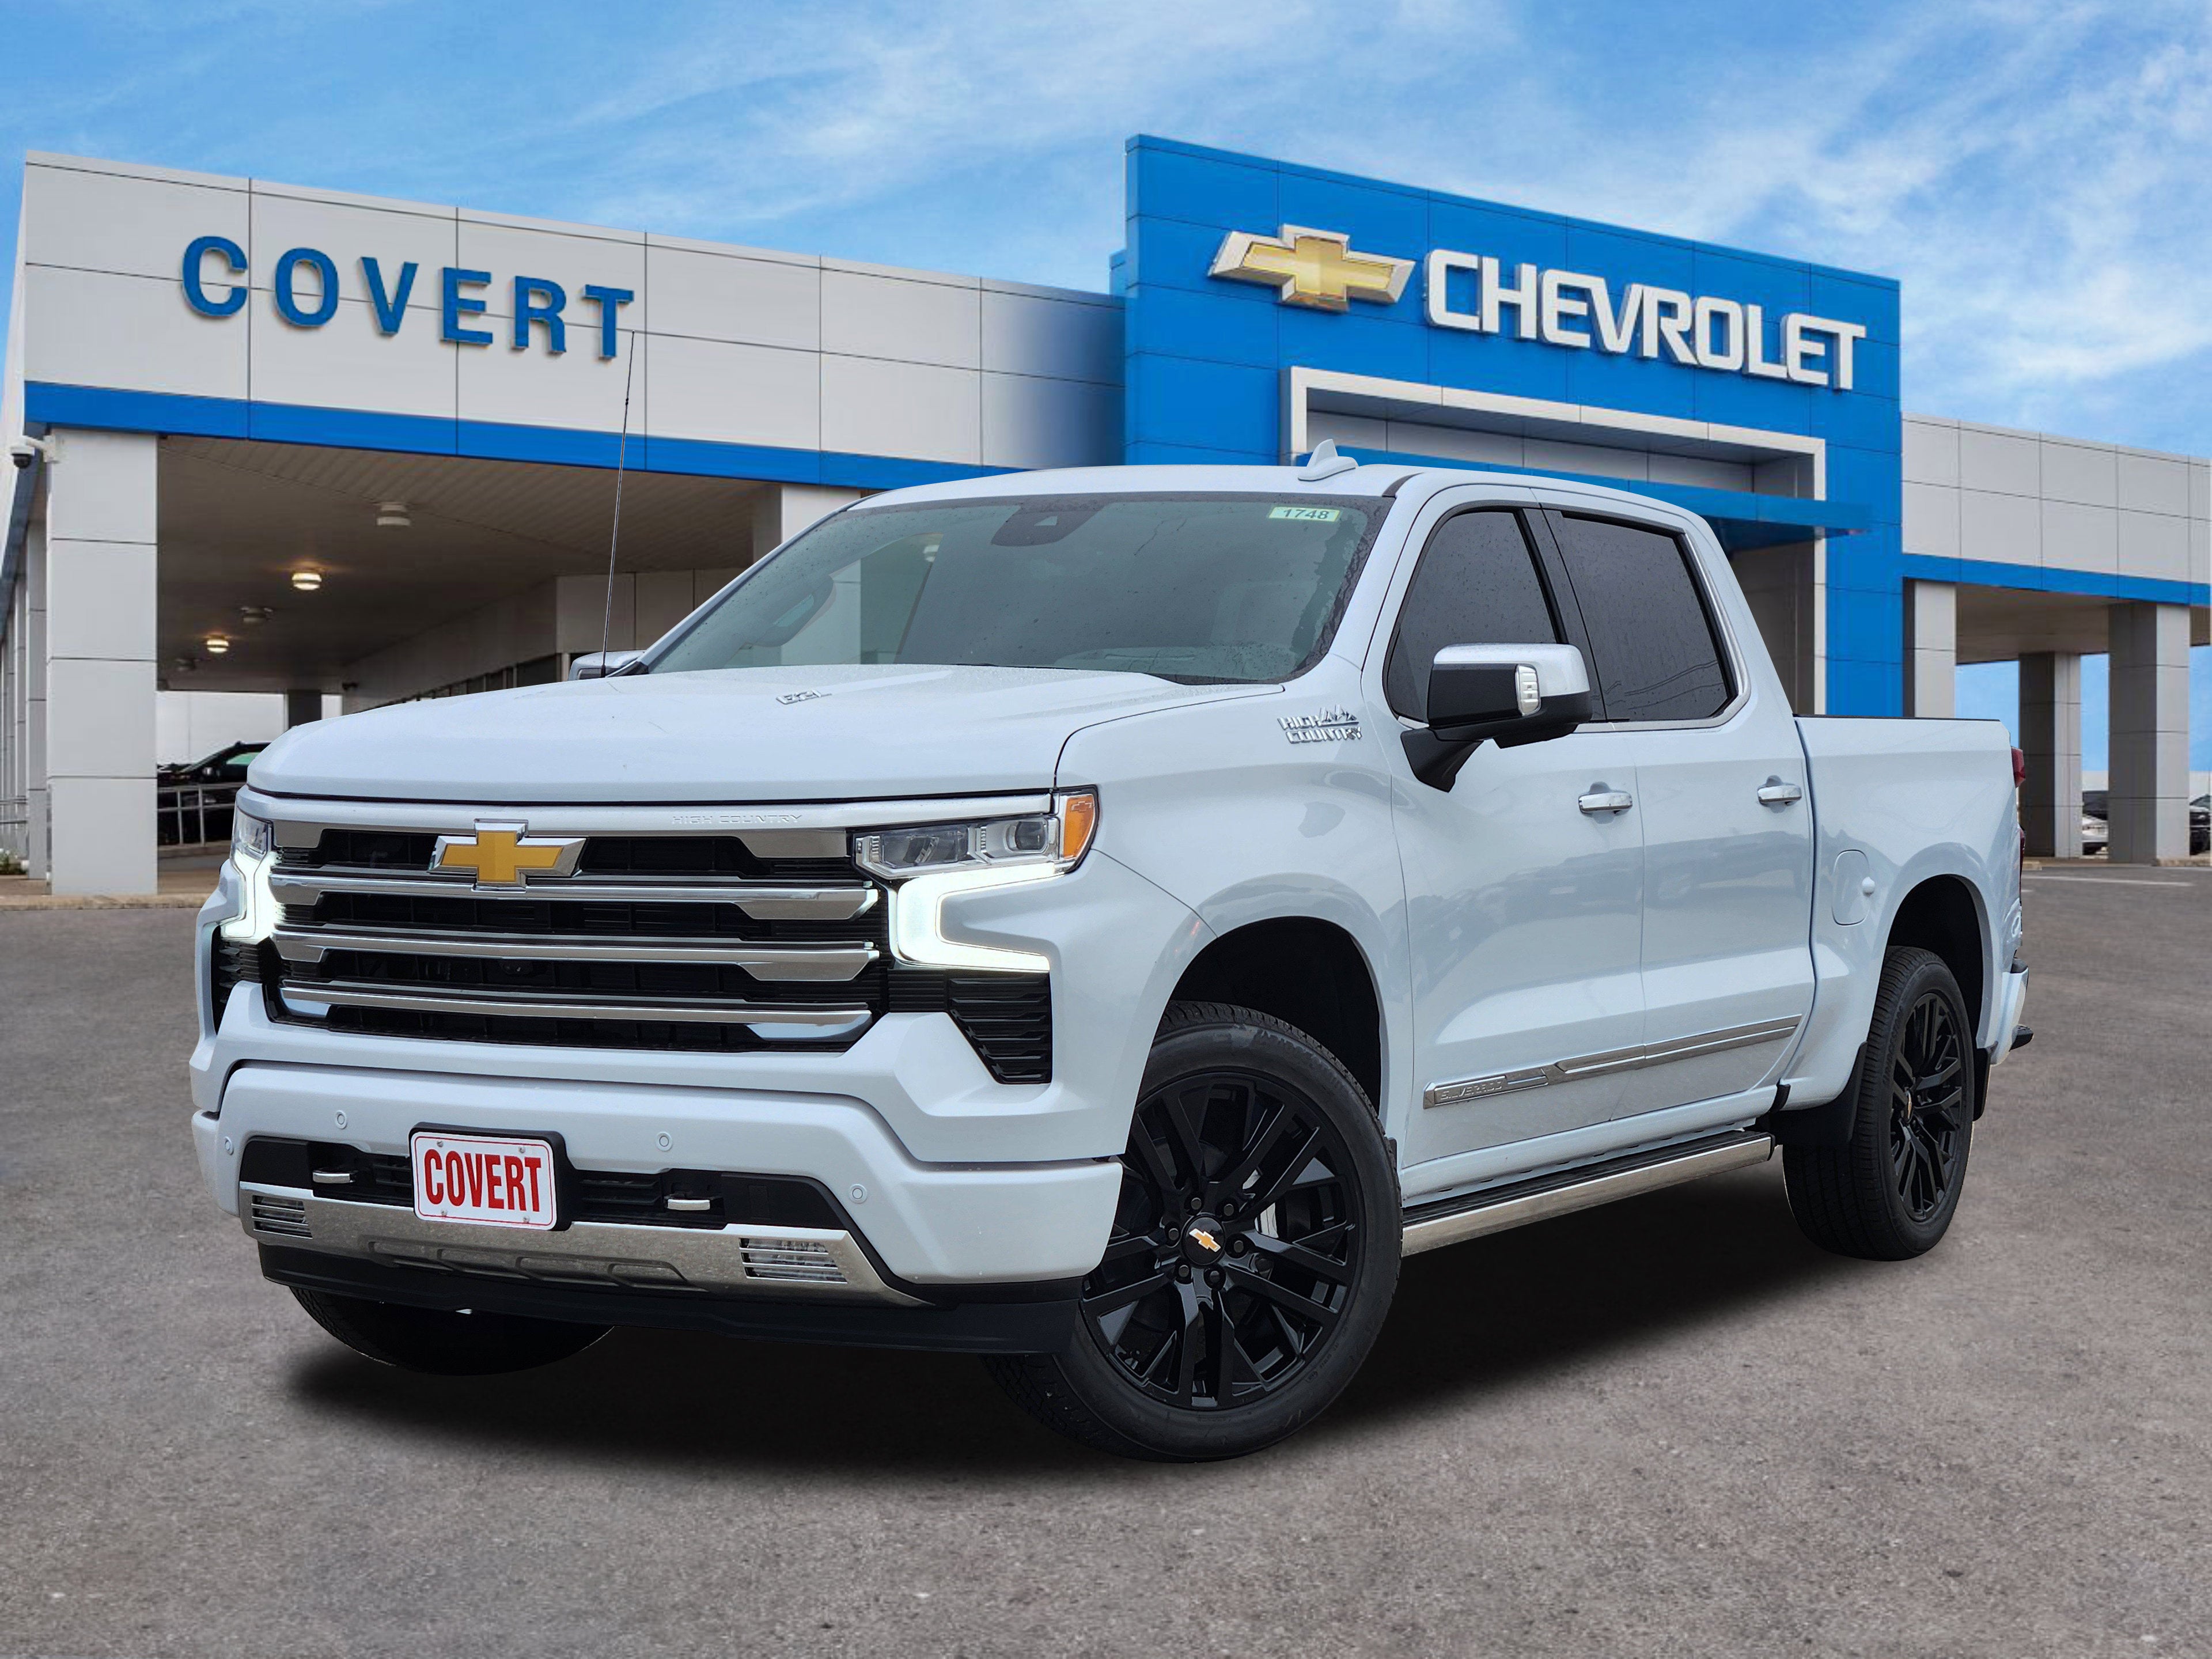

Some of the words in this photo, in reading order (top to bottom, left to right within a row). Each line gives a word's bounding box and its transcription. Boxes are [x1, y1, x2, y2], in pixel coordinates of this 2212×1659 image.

[181, 236, 635, 361] COVERT
[1423, 248, 1866, 391] CHEVROLET
[1283, 509, 1330, 519] 1748
[1277, 715, 1323, 730] HIGH
[1286, 726, 1362, 744] COUNTRY
[672, 815, 713, 824] HIGH
[719, 814, 802, 823] COUNTRY
[424, 1149, 541, 1212] COVERT
